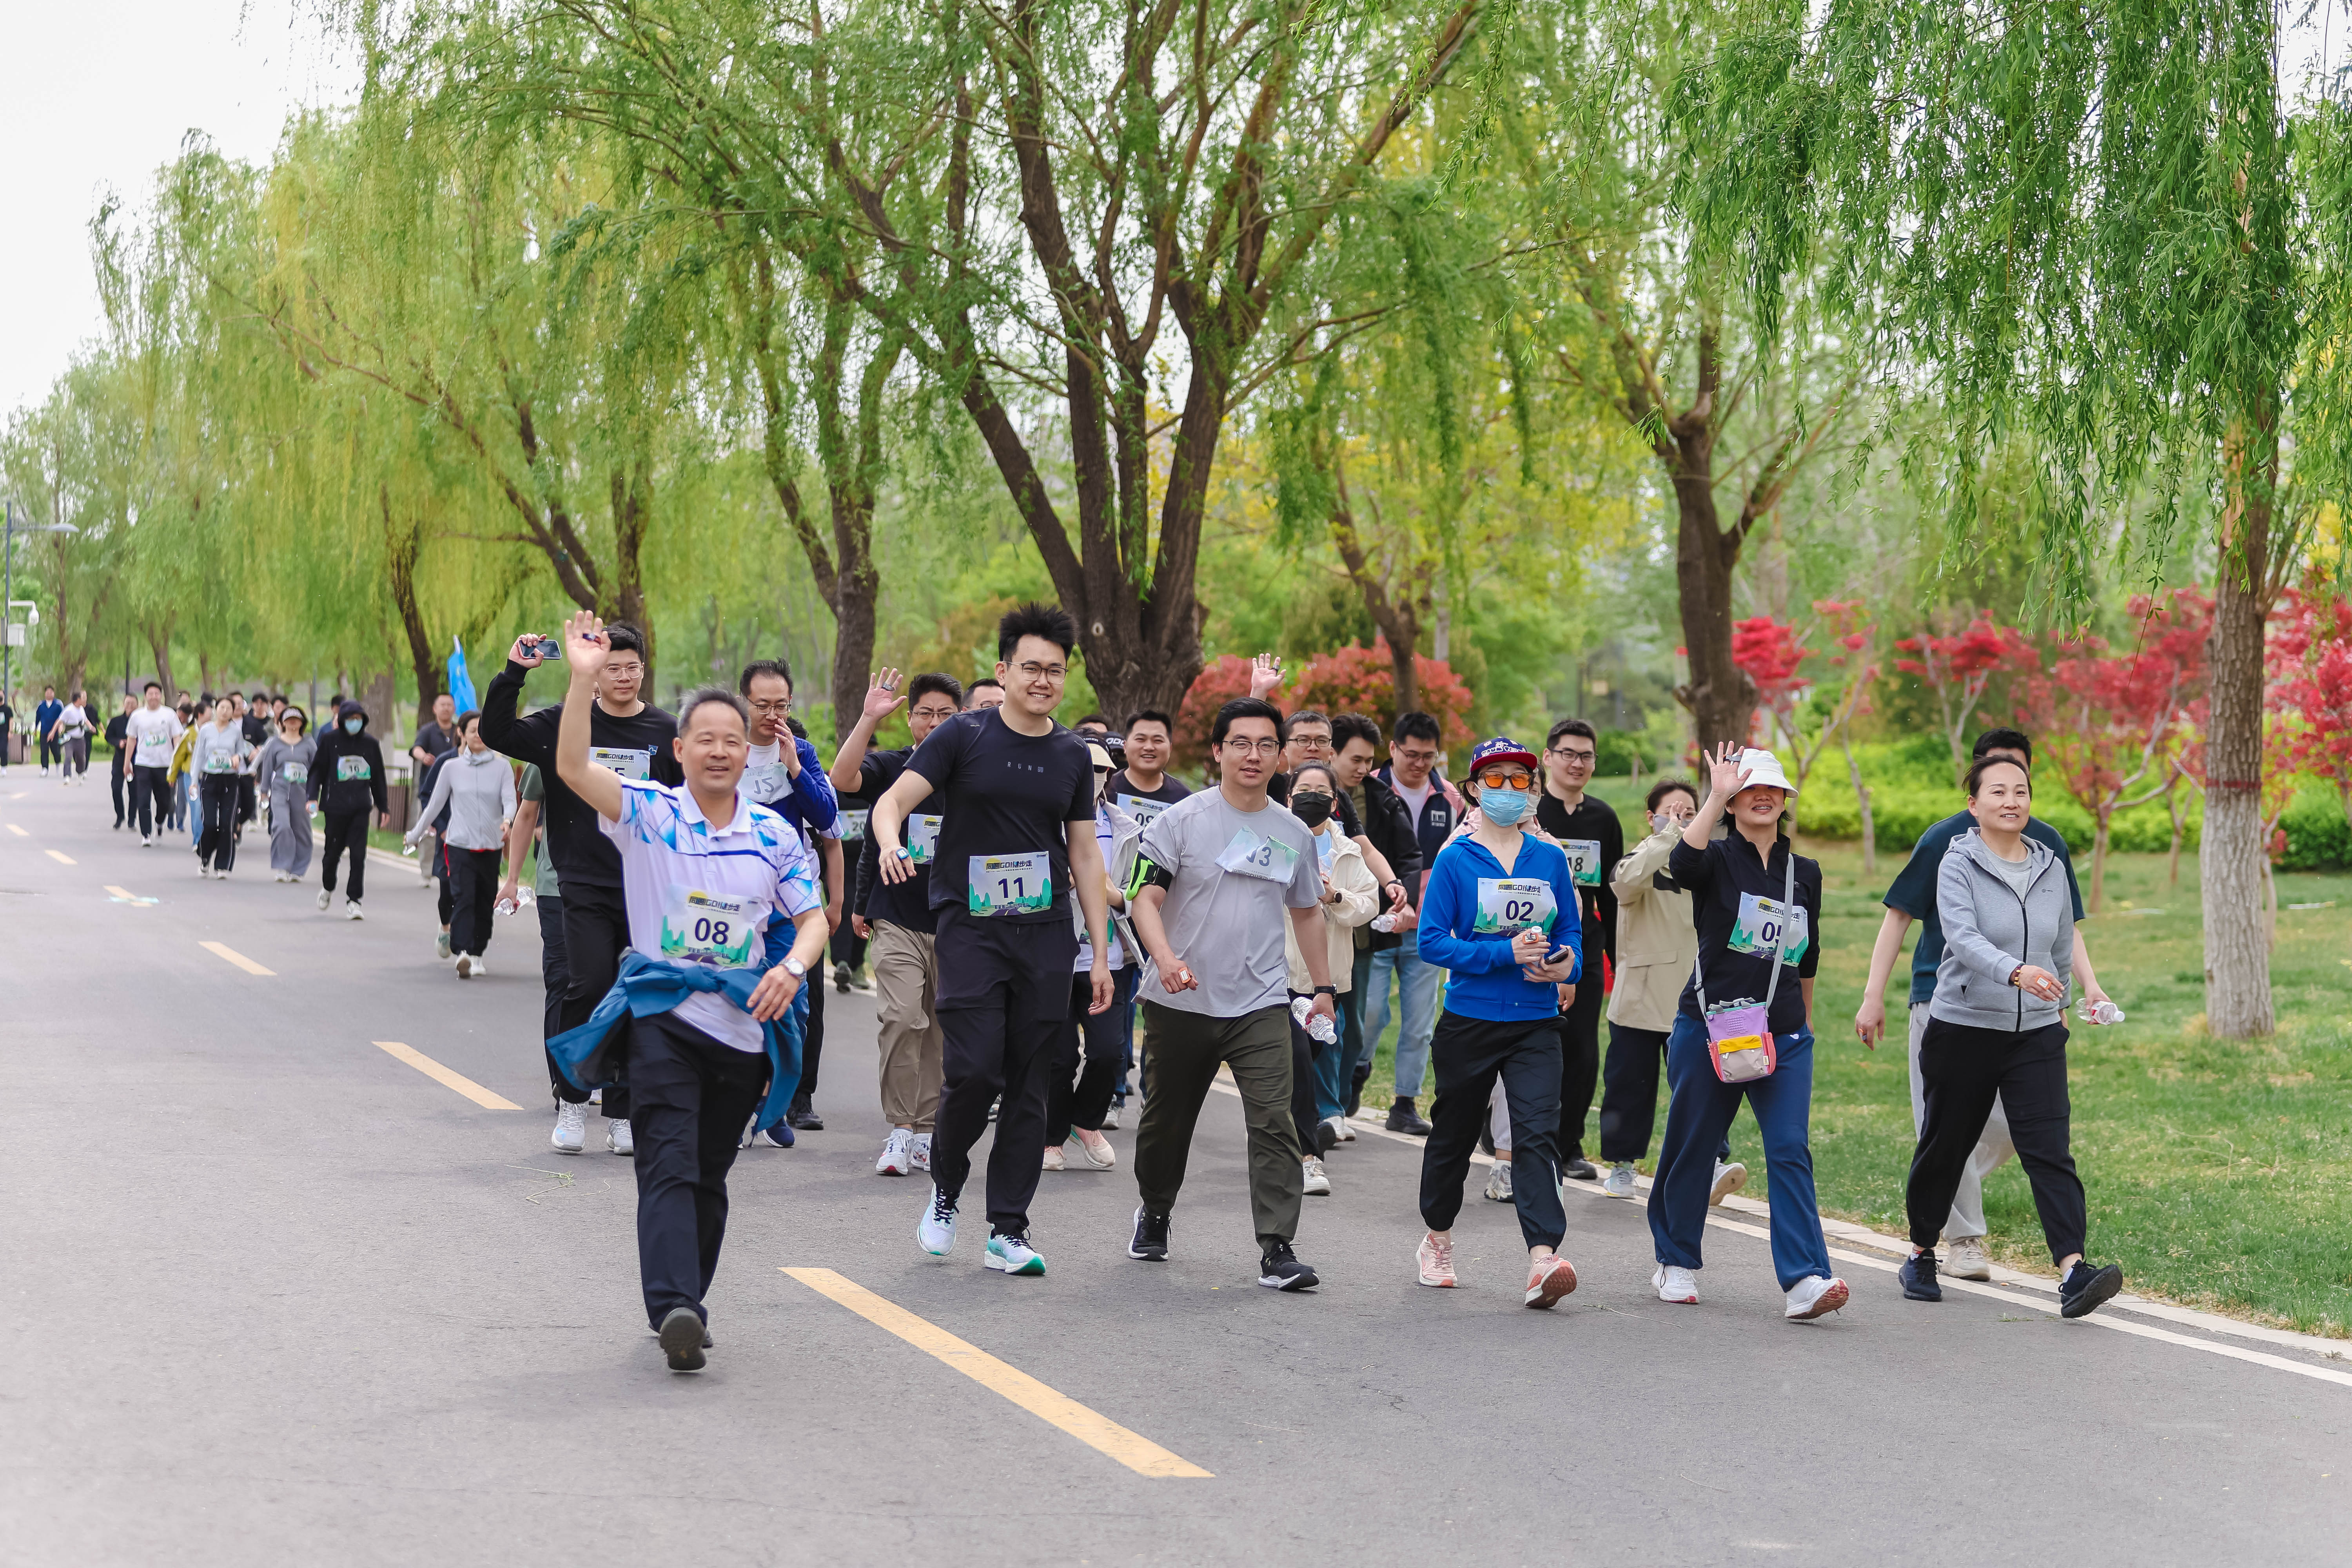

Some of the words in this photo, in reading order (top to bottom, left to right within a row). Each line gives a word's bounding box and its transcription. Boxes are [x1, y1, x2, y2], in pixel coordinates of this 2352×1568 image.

[998, 877, 1024, 898] 11
[1506, 900, 1534, 921] 02
[695, 917, 730, 945] 08
